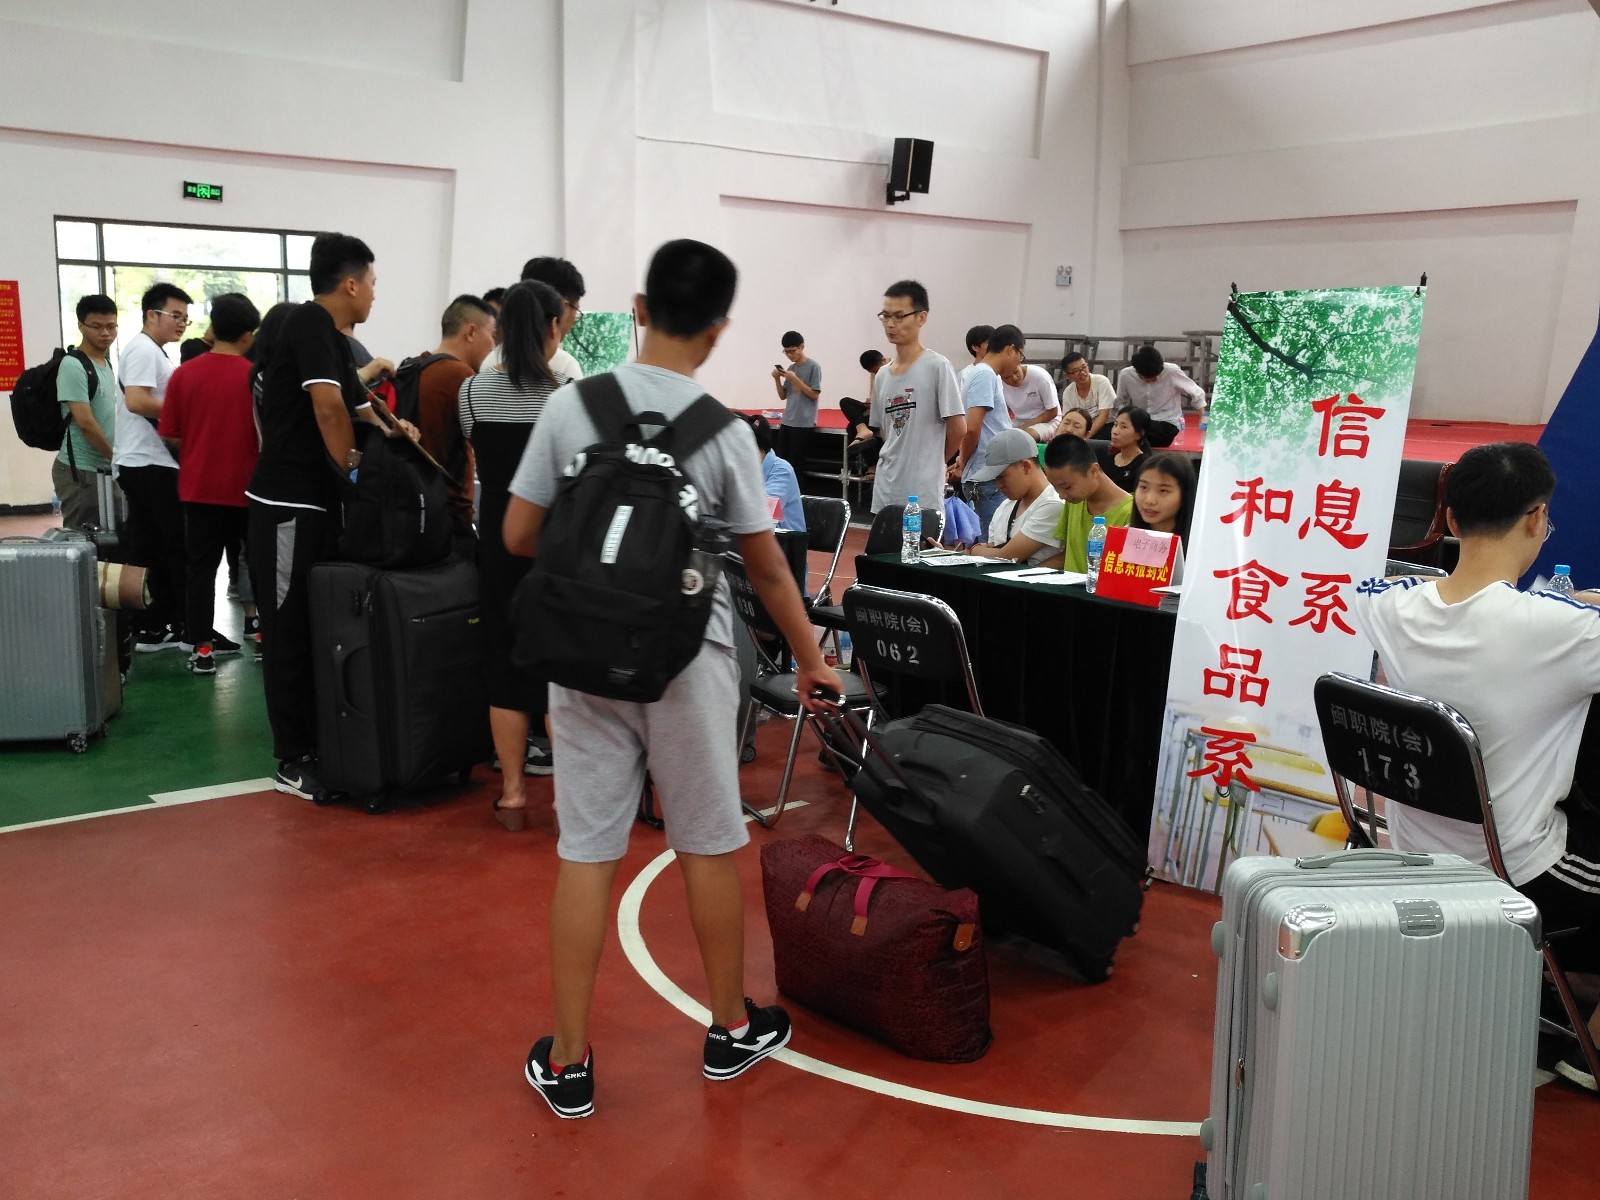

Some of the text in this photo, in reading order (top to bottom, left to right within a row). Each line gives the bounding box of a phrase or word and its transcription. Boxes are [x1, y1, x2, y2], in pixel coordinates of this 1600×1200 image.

[1288, 392, 1385, 635] 信息系
[876, 639, 920, 665] 062
[1187, 477, 1294, 793] 和食品系
[1357, 747, 1421, 790] 173
[708, 1032, 728, 1041] ERKE
[564, 1071, 588, 1080] ERKE
